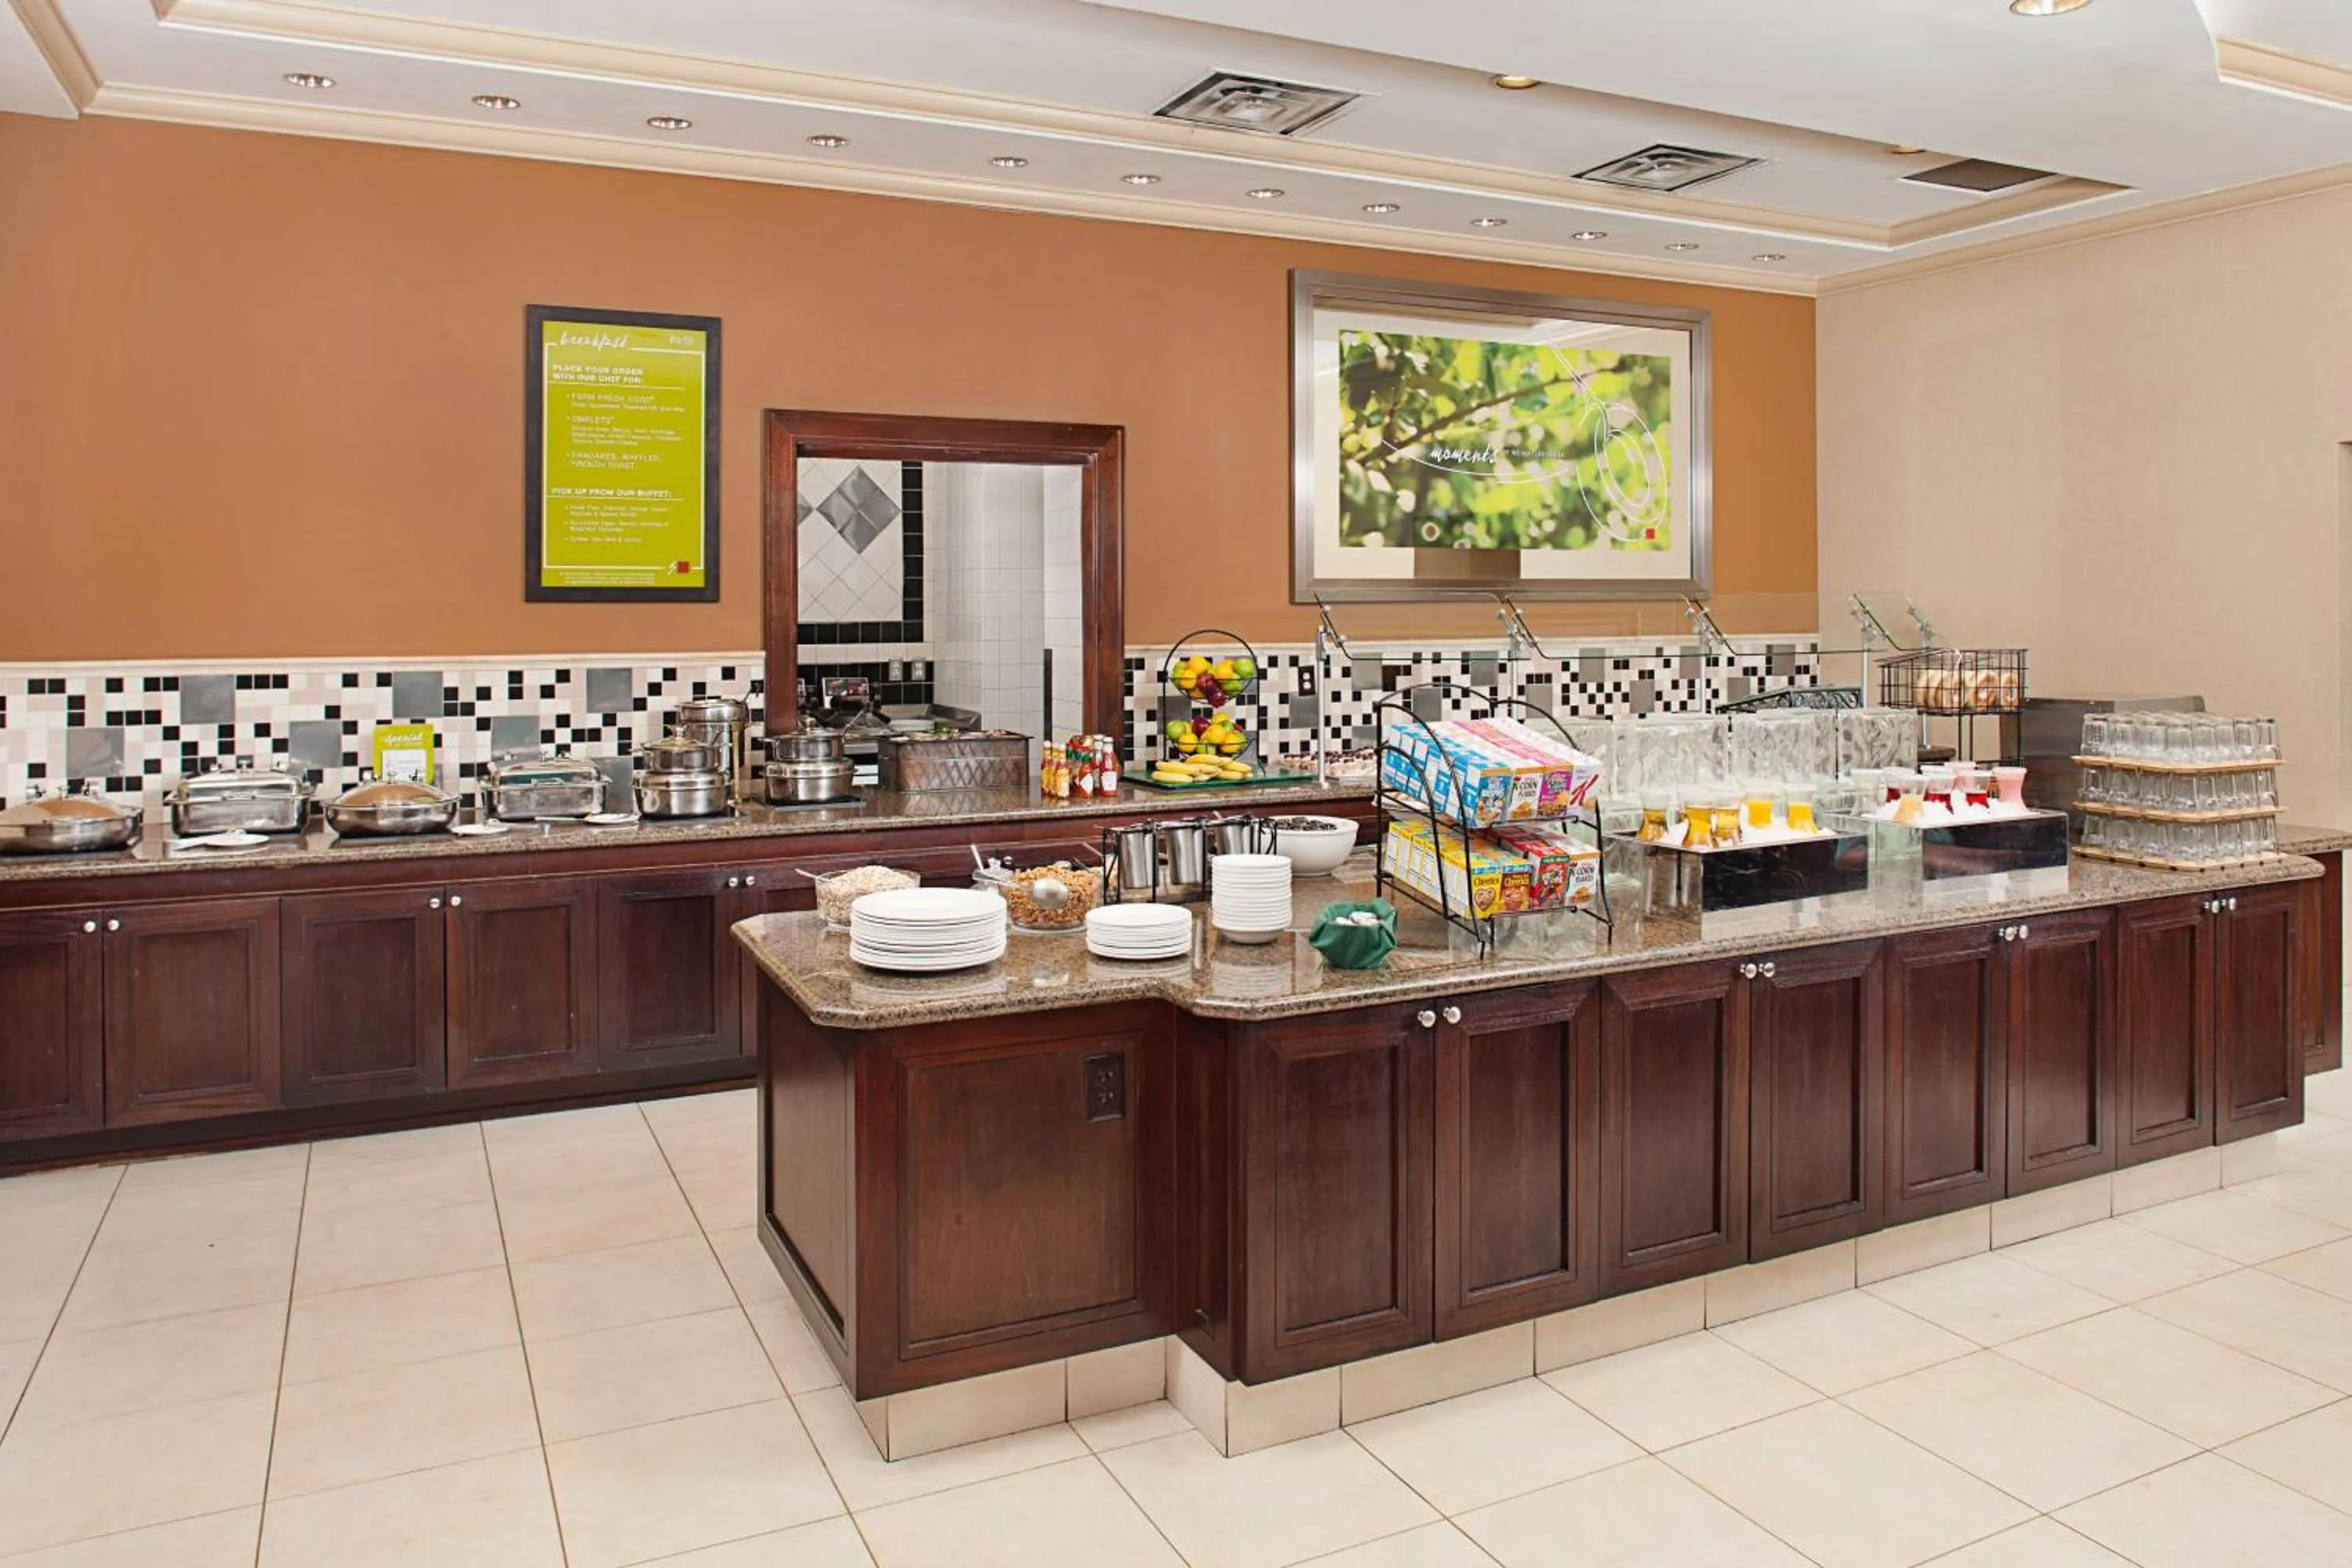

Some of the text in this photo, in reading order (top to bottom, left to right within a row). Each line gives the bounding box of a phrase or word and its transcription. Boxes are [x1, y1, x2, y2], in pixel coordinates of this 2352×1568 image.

[561, 331, 628, 351] breakfast
[553, 364, 644, 376] PLACE YOUR ORDER
[1429, 443, 1497, 464] moments
[552, 487, 572, 495] PICK
[589, 488, 614, 496] FROM
[1576, 865, 1595, 876] CORN
[1473, 877, 1499, 886] Cheerios
